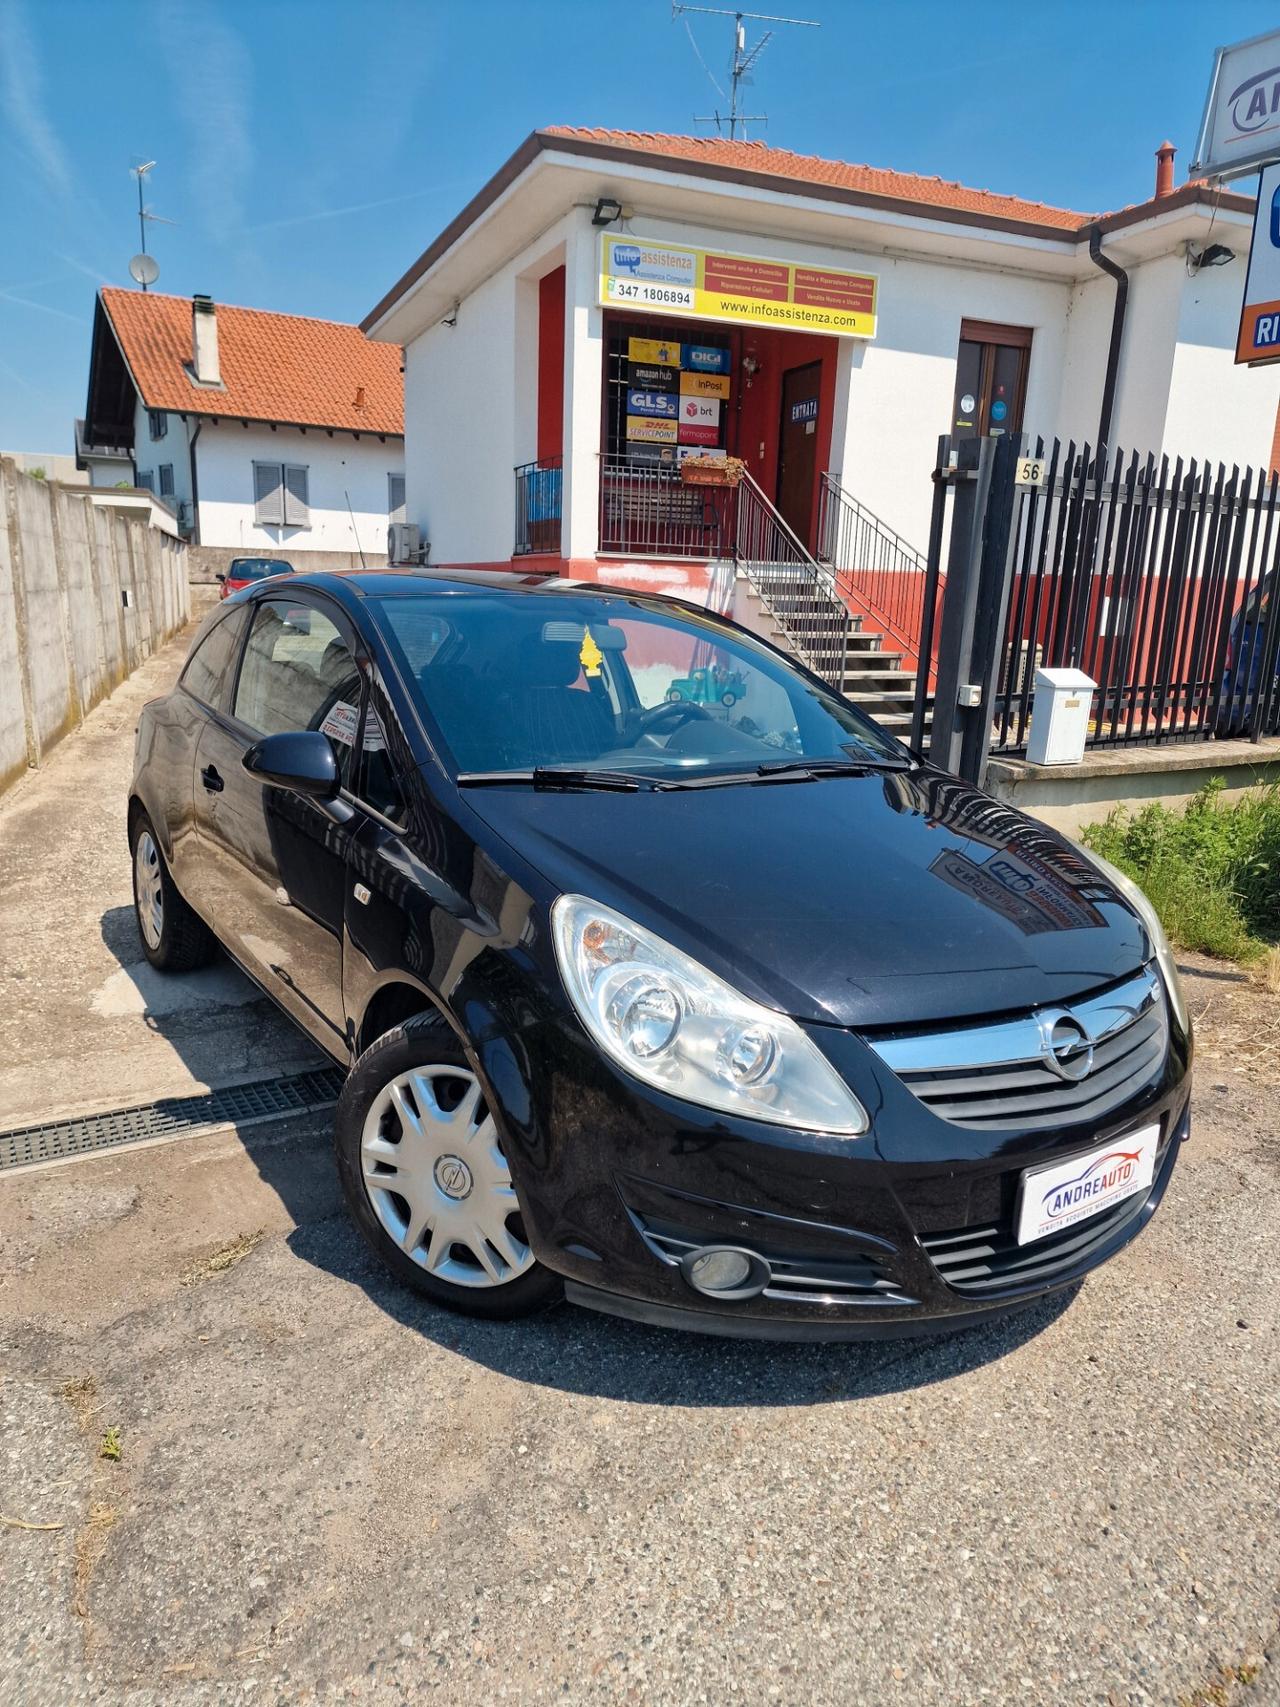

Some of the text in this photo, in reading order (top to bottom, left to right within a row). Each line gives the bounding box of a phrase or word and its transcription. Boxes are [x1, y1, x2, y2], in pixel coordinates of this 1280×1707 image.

[619, 284, 690, 304] 347 1806894
[720, 301, 856, 326] www.infoassistenza.com
[691, 351, 721, 363] DIGI
[636, 369, 672, 380] amazon hub
[698, 380, 722, 391] InPost
[631, 393, 667, 409] GLS
[700, 406, 712, 417] brt
[792, 401, 817, 420] ENTRATA
[645, 421, 670, 430] DHL
[1022, 463, 1040, 480] 56
[1052, 1162, 1132, 1212] ANDREAUTO
